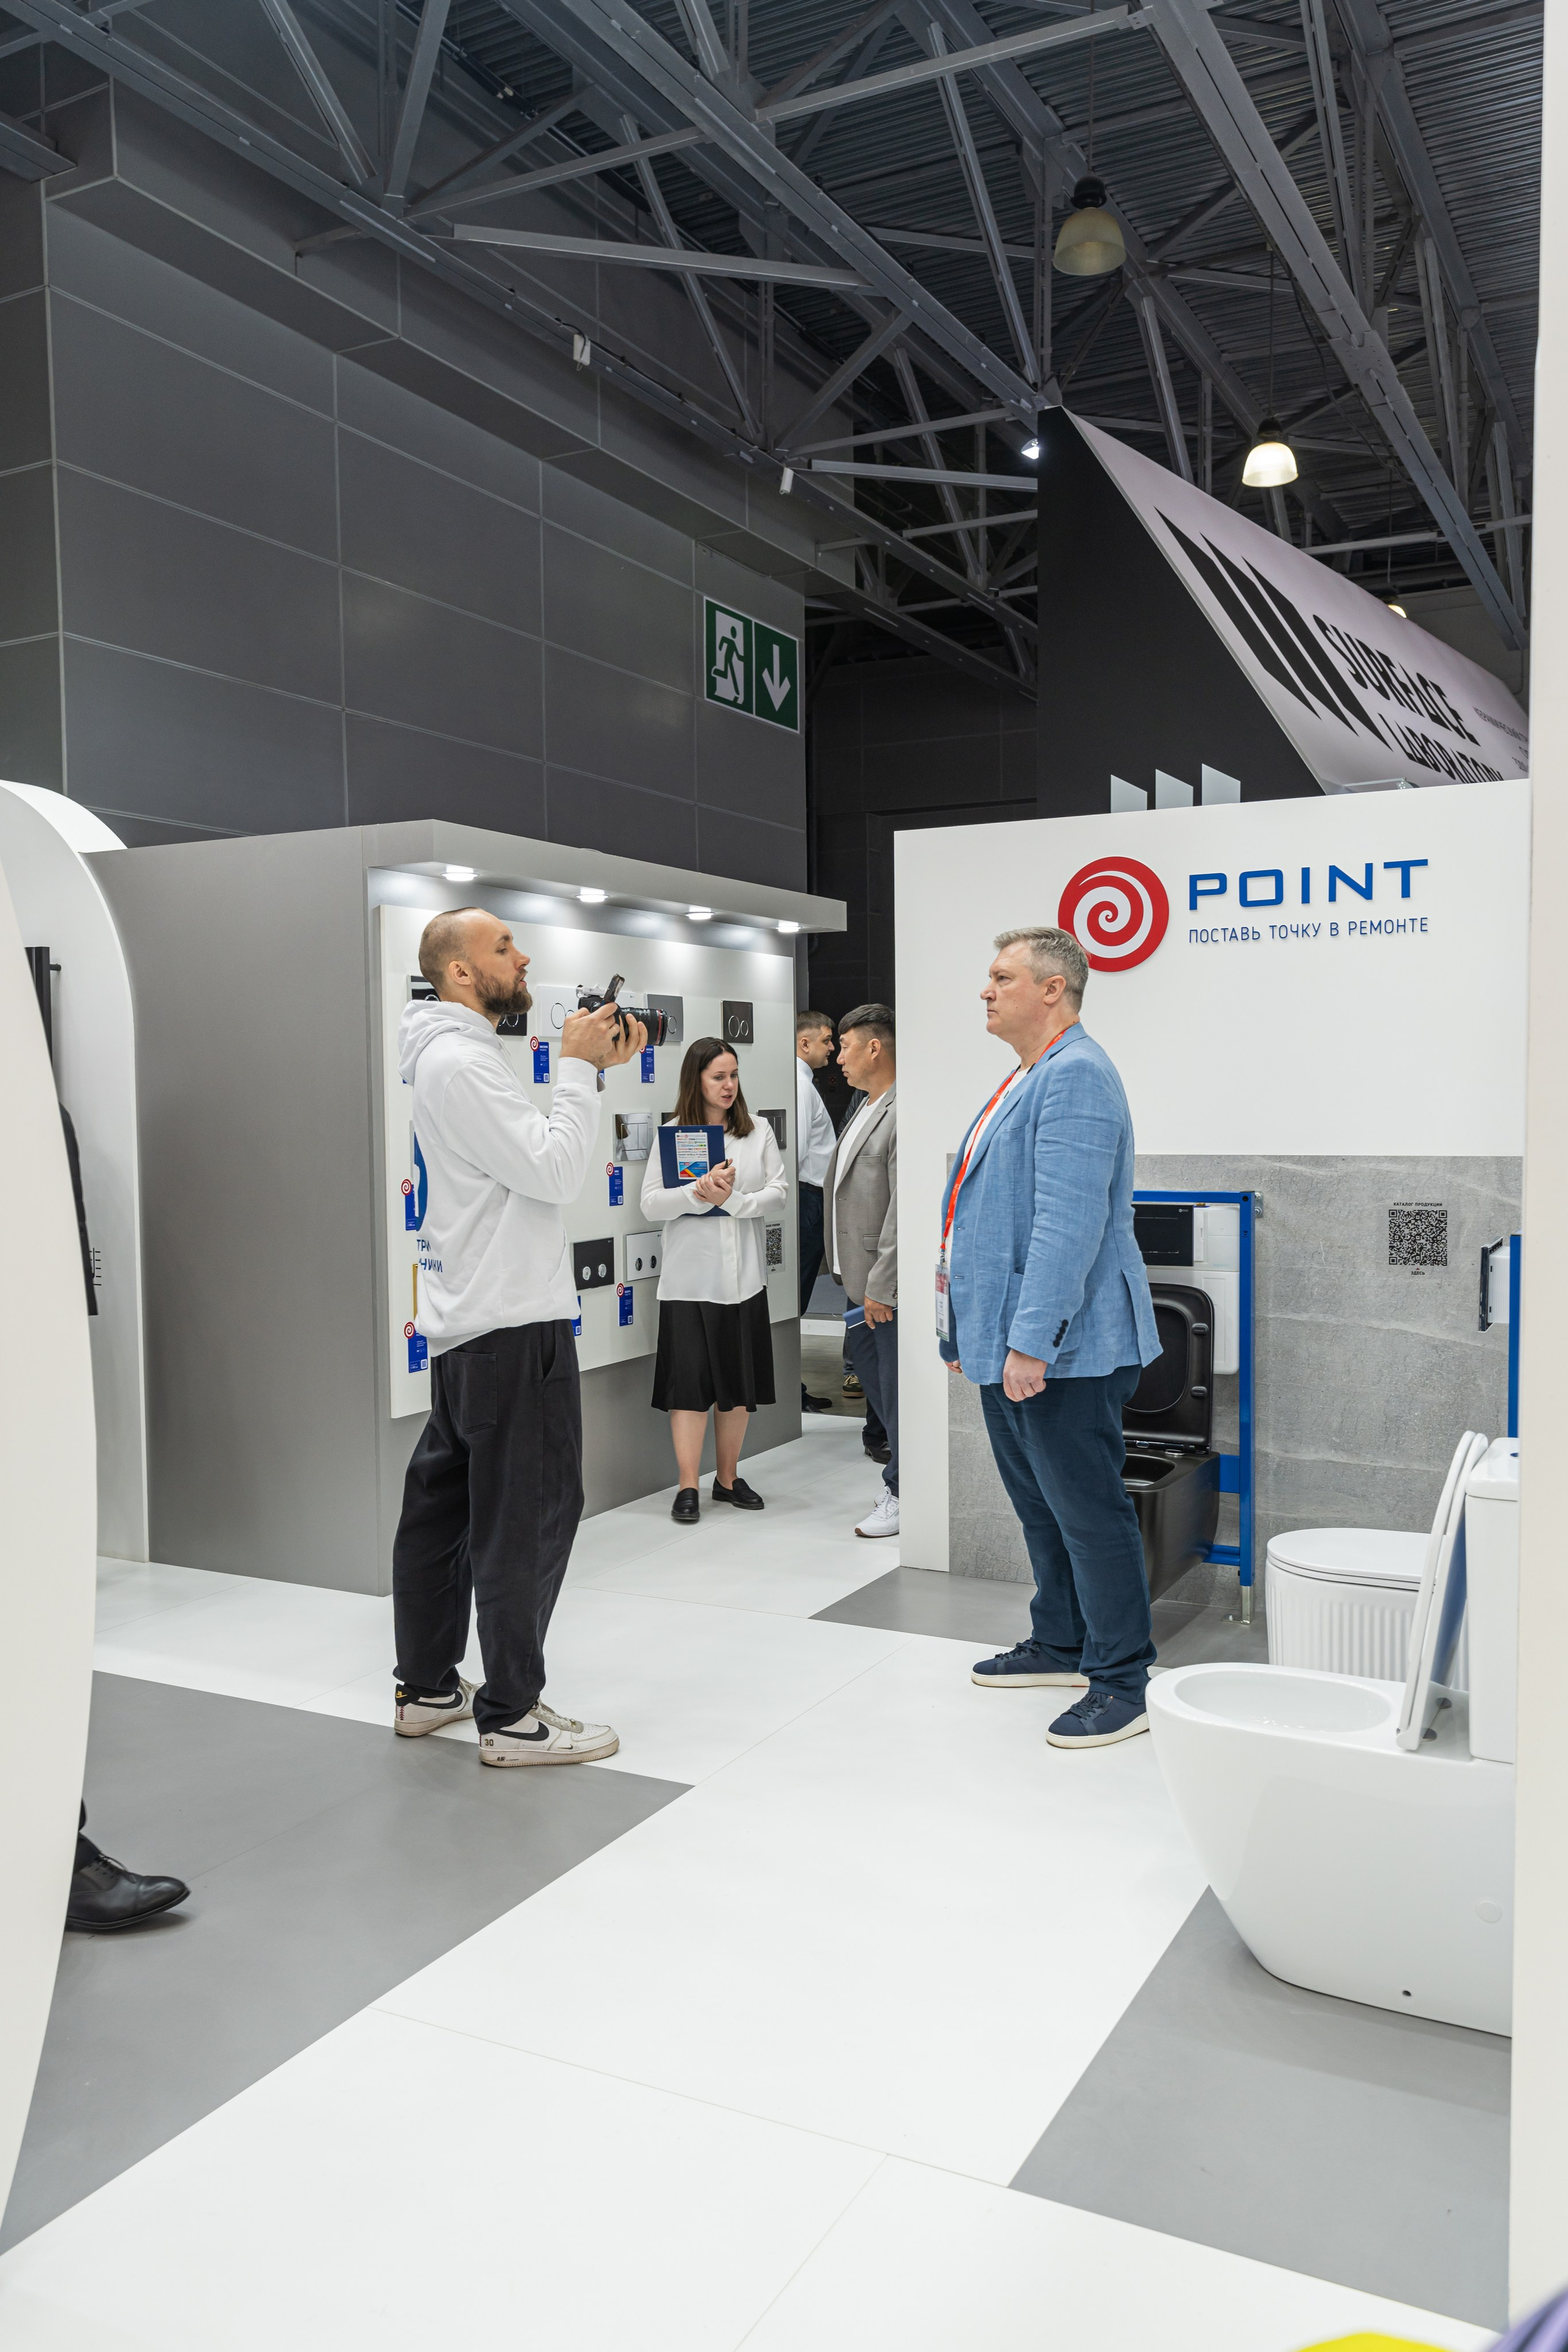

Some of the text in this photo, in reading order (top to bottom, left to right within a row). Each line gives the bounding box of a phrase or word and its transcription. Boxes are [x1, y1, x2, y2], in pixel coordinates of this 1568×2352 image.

[1313, 614, 1481, 747] SURFACE
[1189, 858, 1429, 911] POINT
[1189, 916, 1429, 944] ПОСТАВЬ ТОЧКУ В РЕМОНТЕ
[484, 1738, 494, 1747] 30
